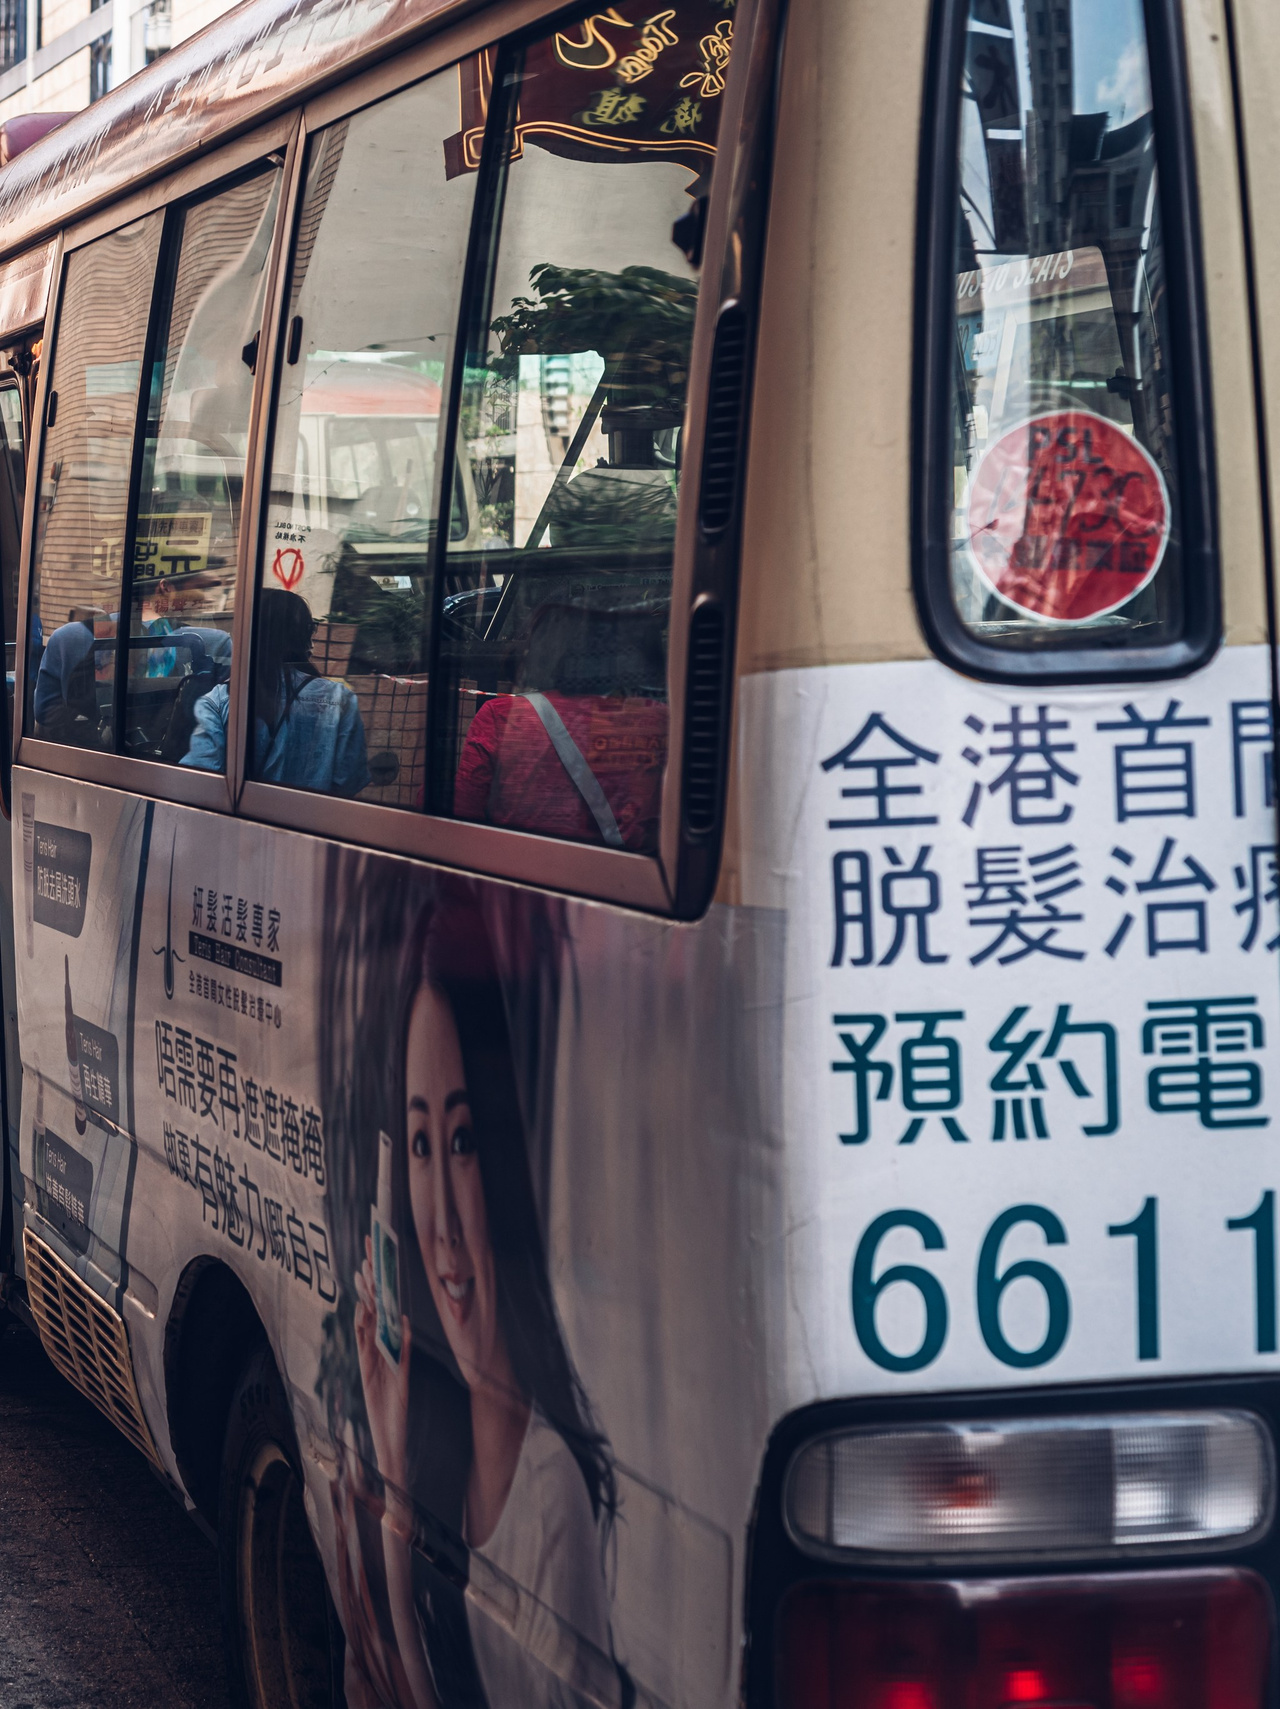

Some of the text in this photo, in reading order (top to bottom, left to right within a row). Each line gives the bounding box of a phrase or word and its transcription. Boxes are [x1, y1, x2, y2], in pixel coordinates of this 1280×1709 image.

[1027, 424, 1105, 465] PSL
[48, 838, 58, 859] Hair
[193, 935, 277, 984] Teris Hair Consultant
[155, 1019, 325, 1187] 唔需要再遮遮掩掩
[830, 995, 1273, 1147] 預約電
[162, 1120, 338, 1304] 做更有魅力嘅自己
[850, 1188, 1277, 1374] 6611
